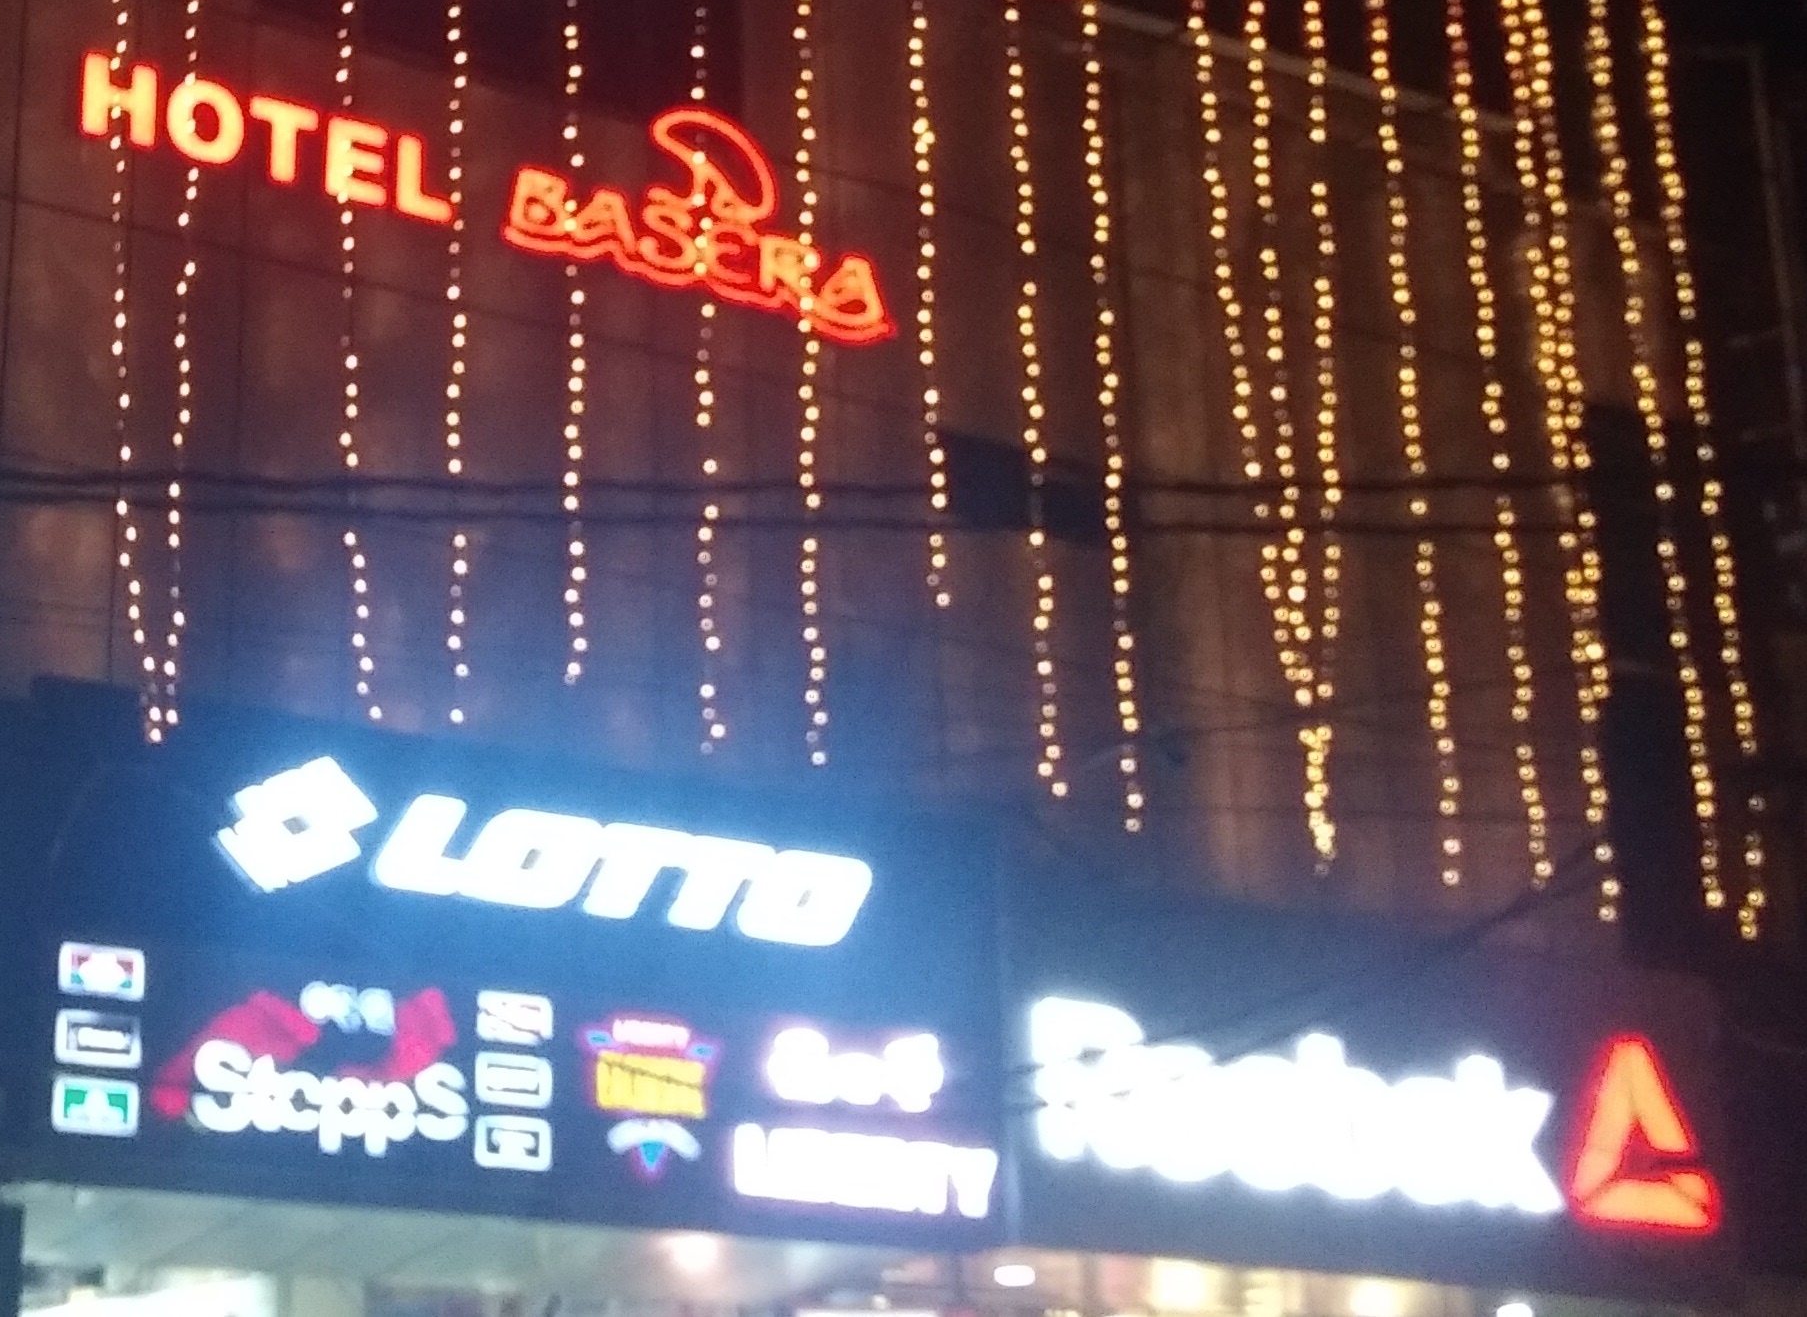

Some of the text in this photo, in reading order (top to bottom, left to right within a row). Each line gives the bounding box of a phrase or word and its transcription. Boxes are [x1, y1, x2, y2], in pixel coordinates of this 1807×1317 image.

[80, 51, 455, 224] HOTEL
[502, 165, 895, 343] BASERA
[374, 793, 875, 947] LOTTO
